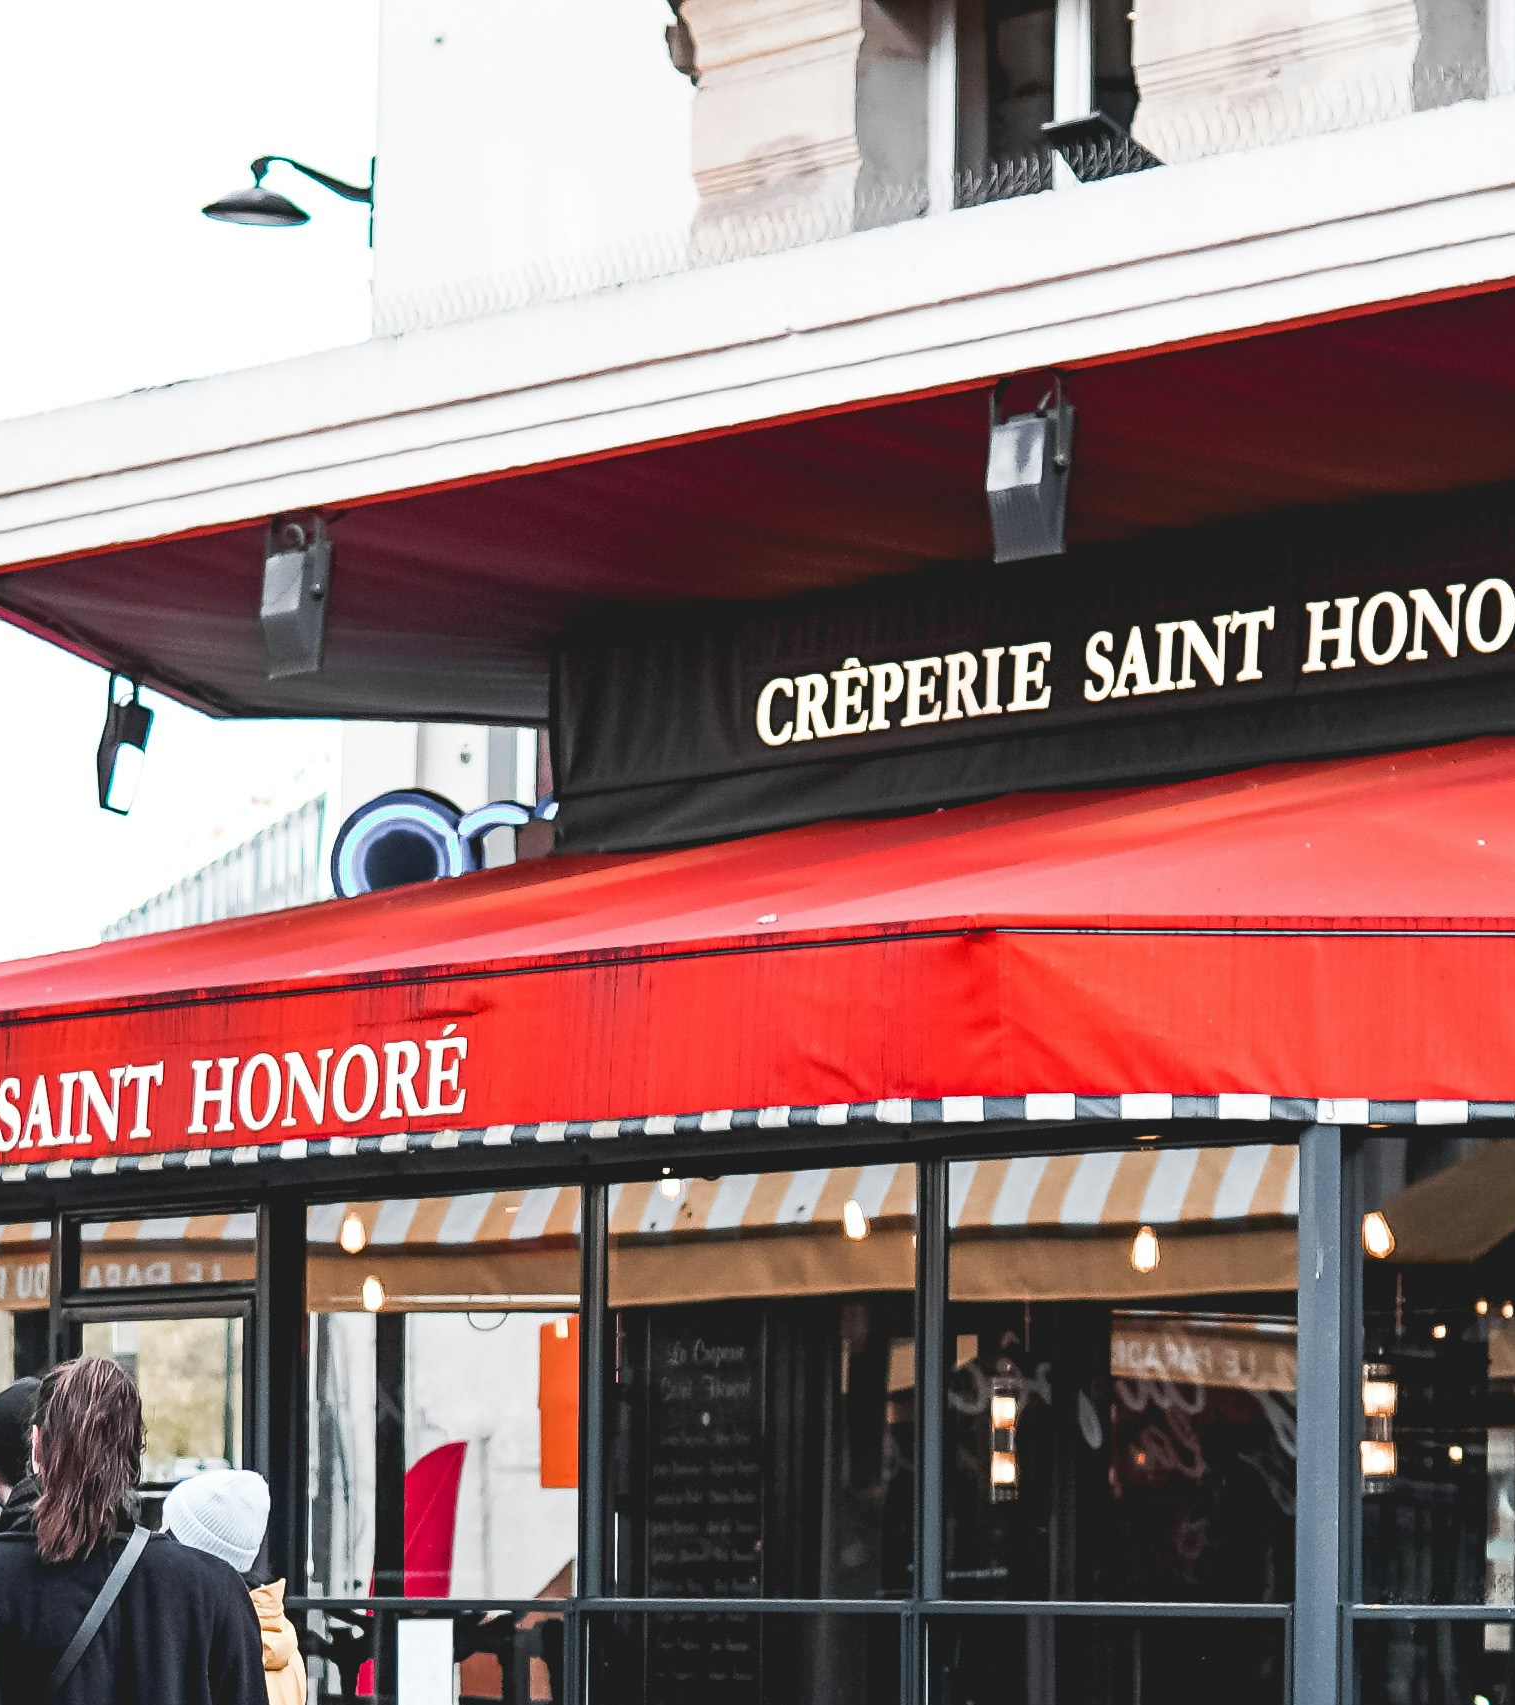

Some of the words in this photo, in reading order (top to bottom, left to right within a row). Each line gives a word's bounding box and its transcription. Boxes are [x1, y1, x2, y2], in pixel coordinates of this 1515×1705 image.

[755, 640, 1053, 747] CRÊPERIE
[1083, 604, 1276, 703] SAINT
[186, 1023, 469, 1135] HONORÉ
